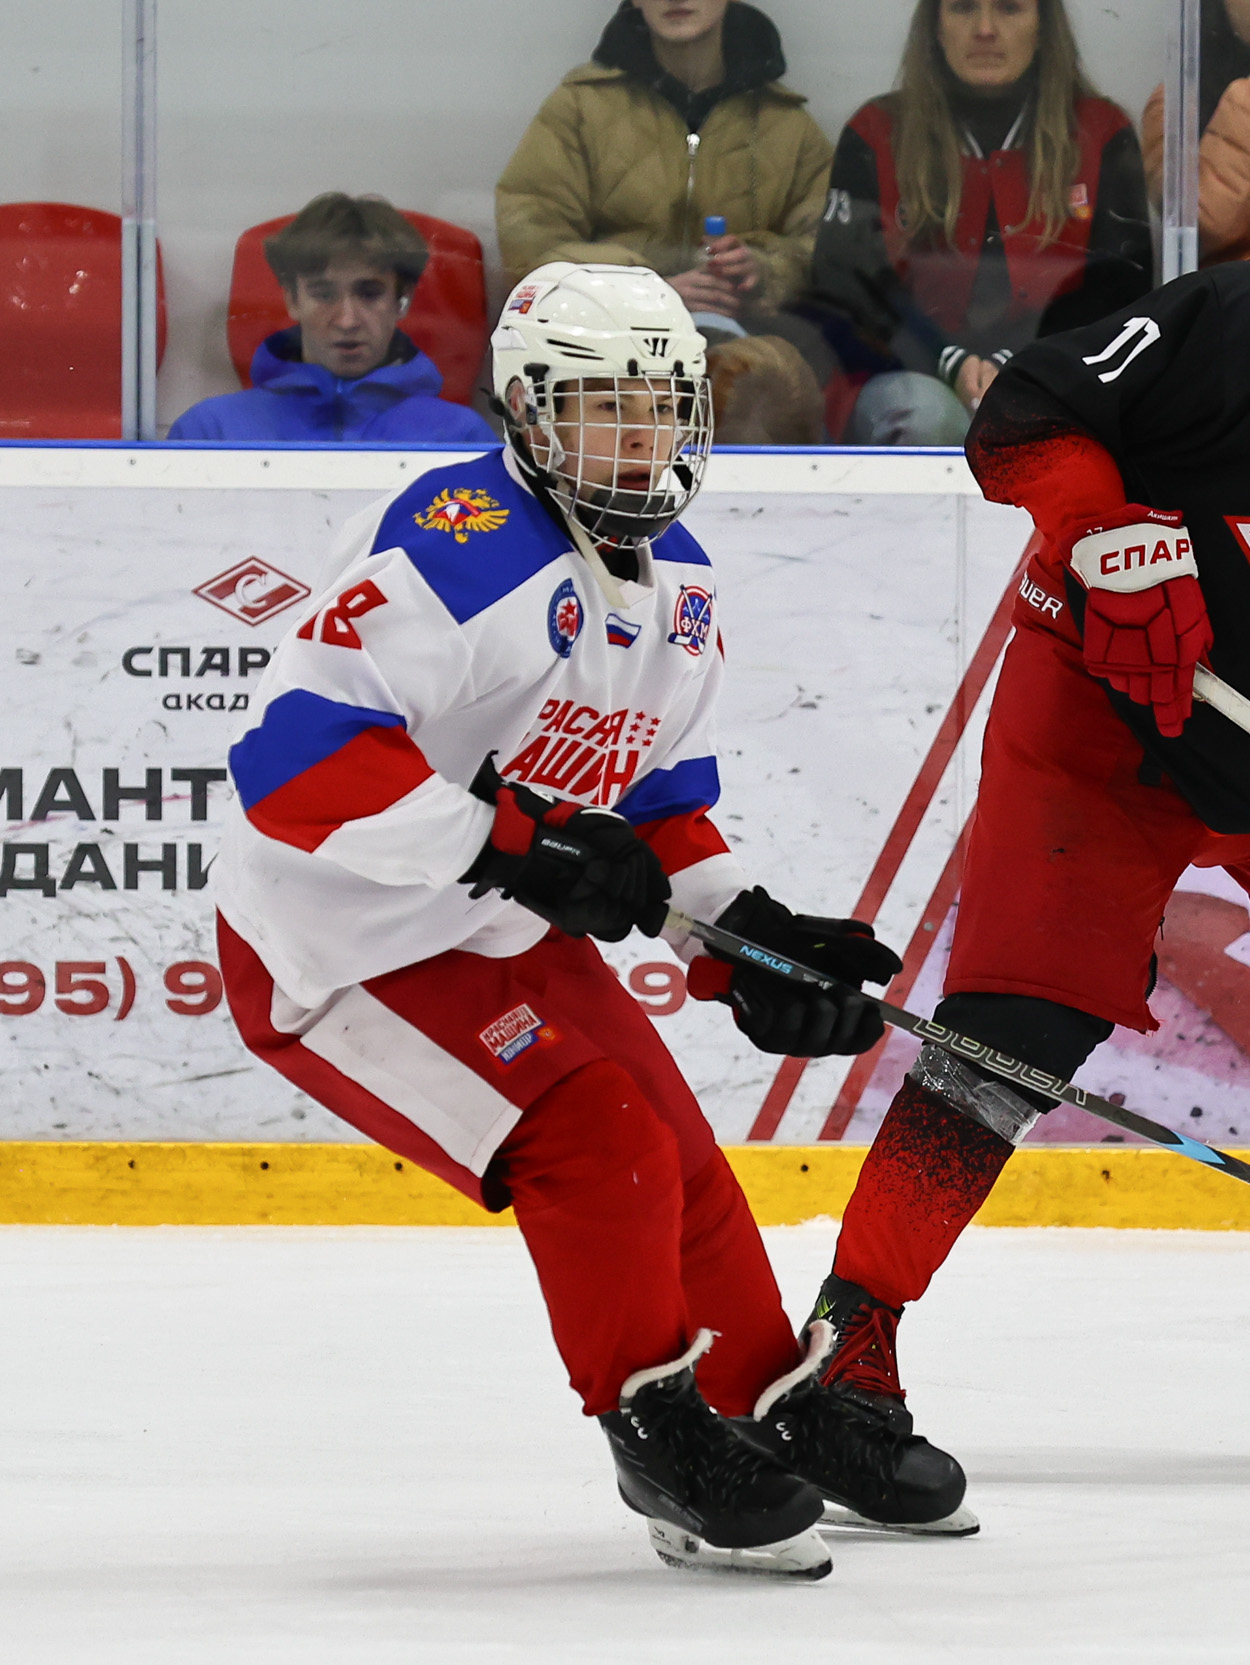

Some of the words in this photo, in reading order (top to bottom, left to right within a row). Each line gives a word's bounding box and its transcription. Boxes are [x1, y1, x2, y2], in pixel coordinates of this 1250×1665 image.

[1081, 316, 1162, 384] 17
[1100, 538, 1194, 576] СПАР
[680, 615, 709, 643] ФХМ
[121, 646, 279, 678] СПАР
[739, 945, 794, 975] NEXUS
[487, 1013, 538, 1055] МАШИНА
